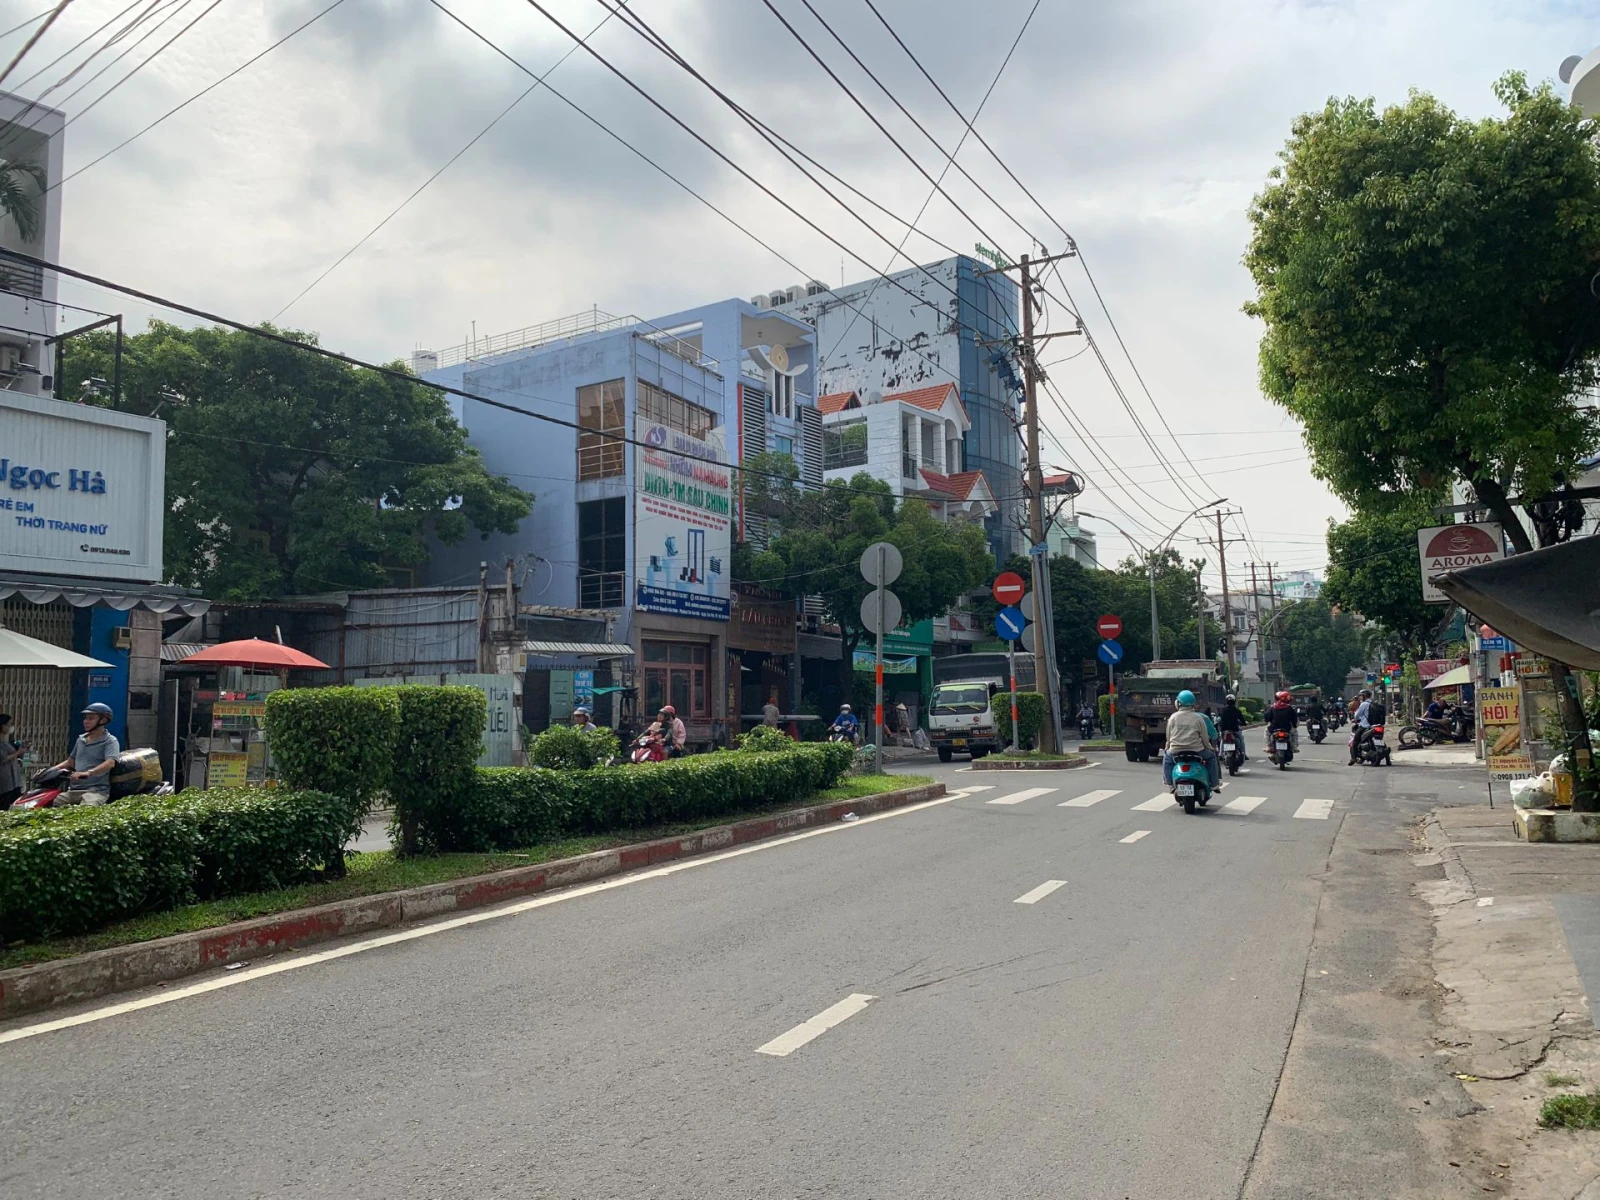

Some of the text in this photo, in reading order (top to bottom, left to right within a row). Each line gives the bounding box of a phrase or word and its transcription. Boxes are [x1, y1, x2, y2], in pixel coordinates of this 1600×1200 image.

[15, 501, 34, 513] EM
[47, 519, 88, 534] TRANG
[1431, 554, 1493, 568] AROMA
[1481, 691, 1514, 701] BÁNH
[1483, 703, 1509, 723] HỘI
